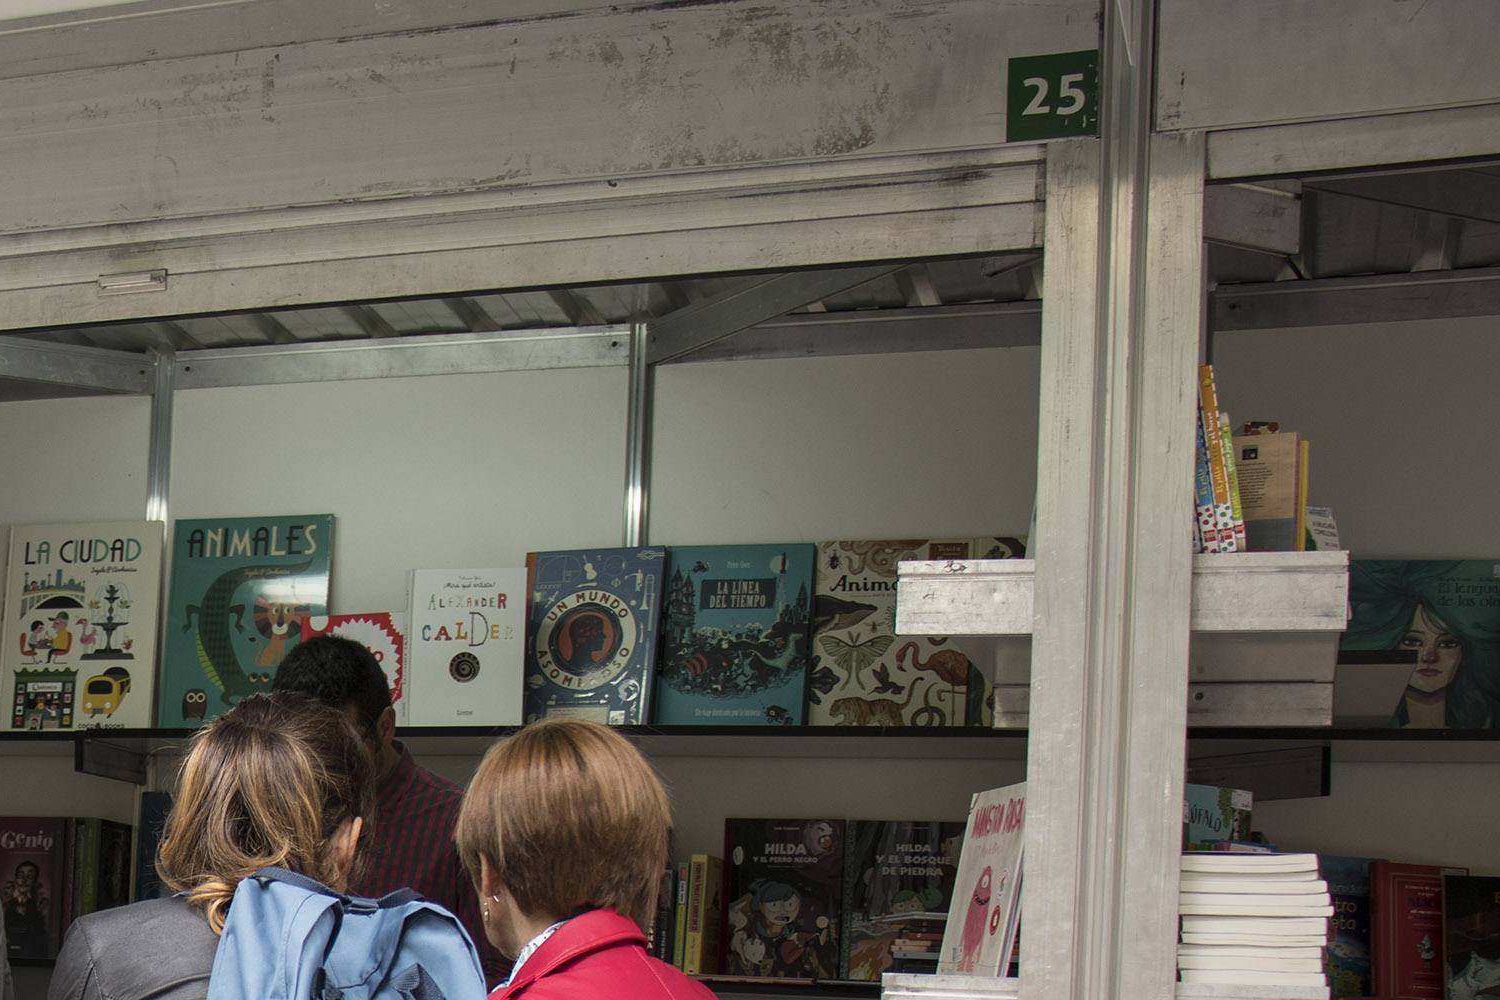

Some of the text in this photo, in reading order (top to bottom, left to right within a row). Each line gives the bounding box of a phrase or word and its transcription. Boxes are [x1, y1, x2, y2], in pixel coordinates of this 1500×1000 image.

[1021, 73, 1086, 115] 25
[187, 524, 318, 558] ANIMALES
[24, 538, 142, 565] LA CIUDAD
[717, 580, 760, 594] LA LÍNEA
[428, 593, 507, 610] ALEXANDER
[547, 592, 629, 621] UN MUNDO
[709, 594, 766, 608] DEL TIEMPO
[422, 612, 515, 647] CALDER
[0, 830, 53, 850] Genio
[764, 843, 808, 855] HILDA
[896, 844, 932, 853] HILDA
[794, 856, 819, 864] NEGRO
[875, 855, 951, 865] Y EL BOSQUE
[882, 867, 944, 876] DE PIEDRA
